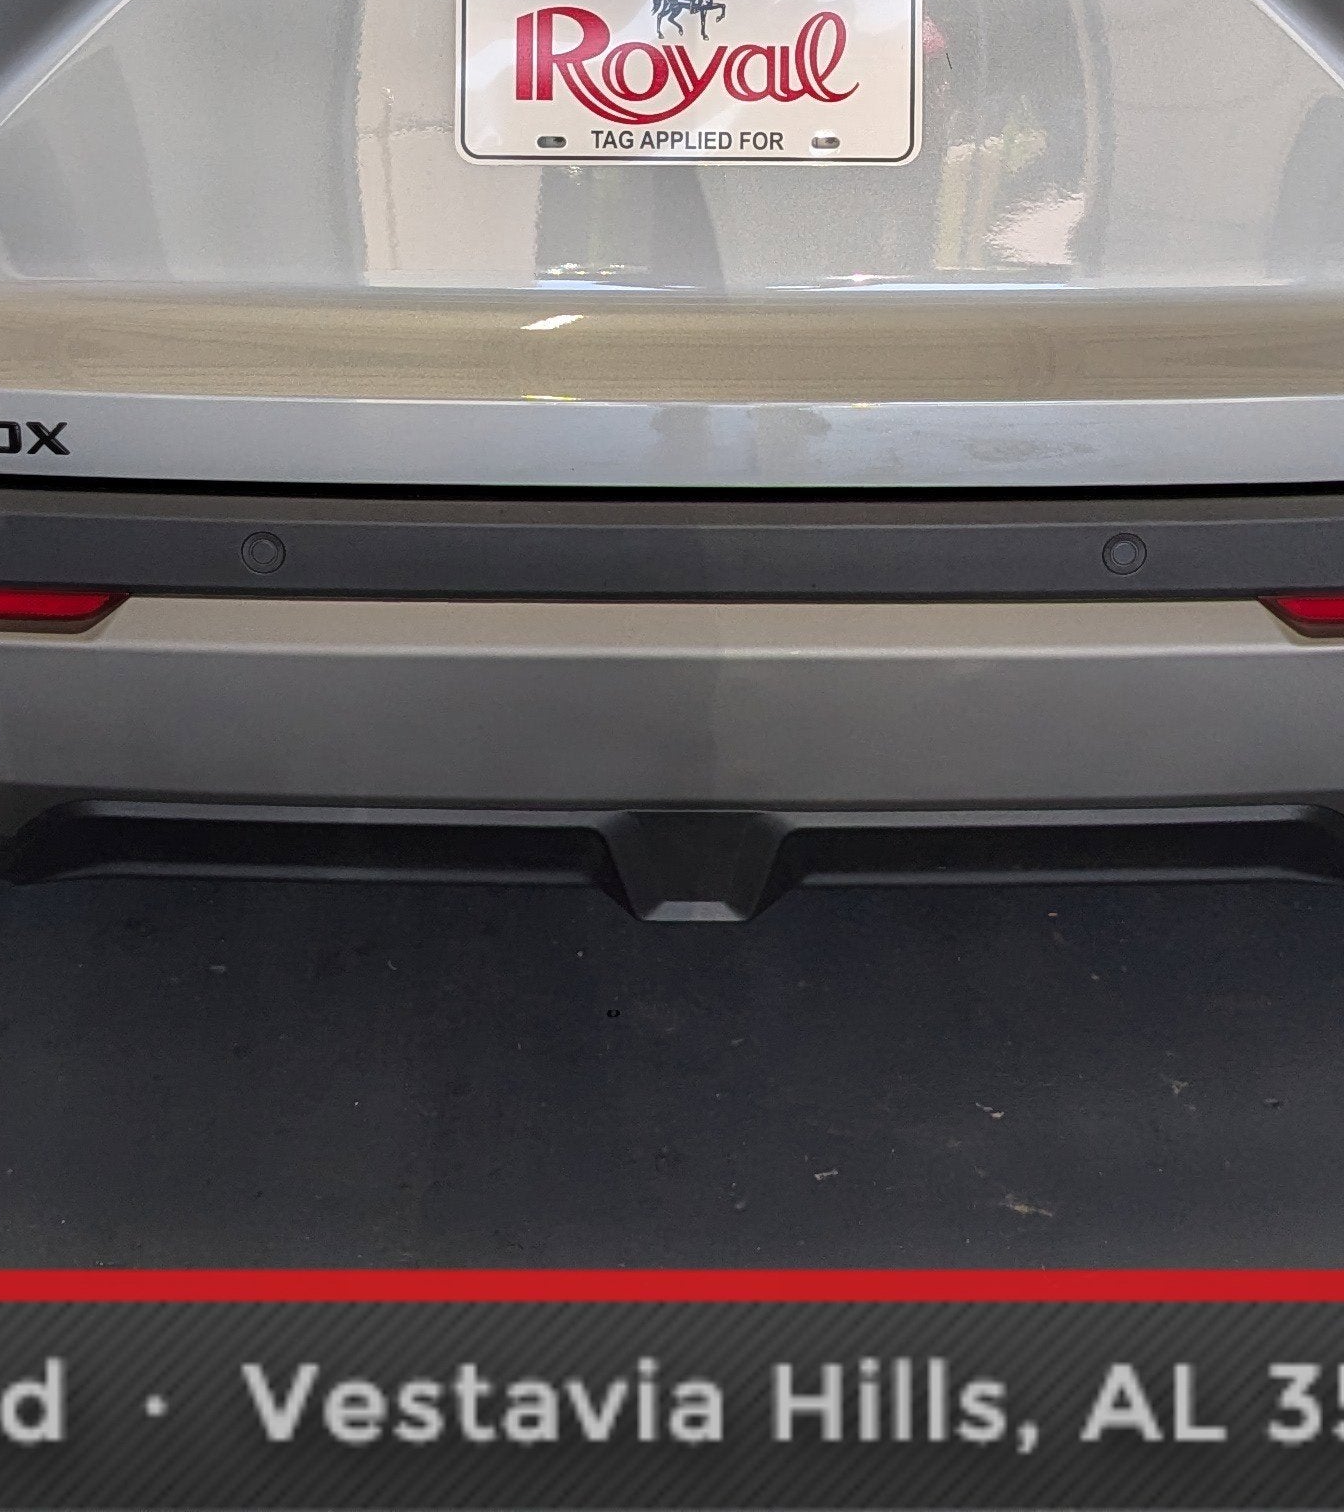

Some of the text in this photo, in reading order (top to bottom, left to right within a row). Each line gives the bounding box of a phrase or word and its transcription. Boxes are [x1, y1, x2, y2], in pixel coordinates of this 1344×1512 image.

[515, 5, 860, 126] Royal
[591, 130, 784, 151] TAG APPLIED FOR
